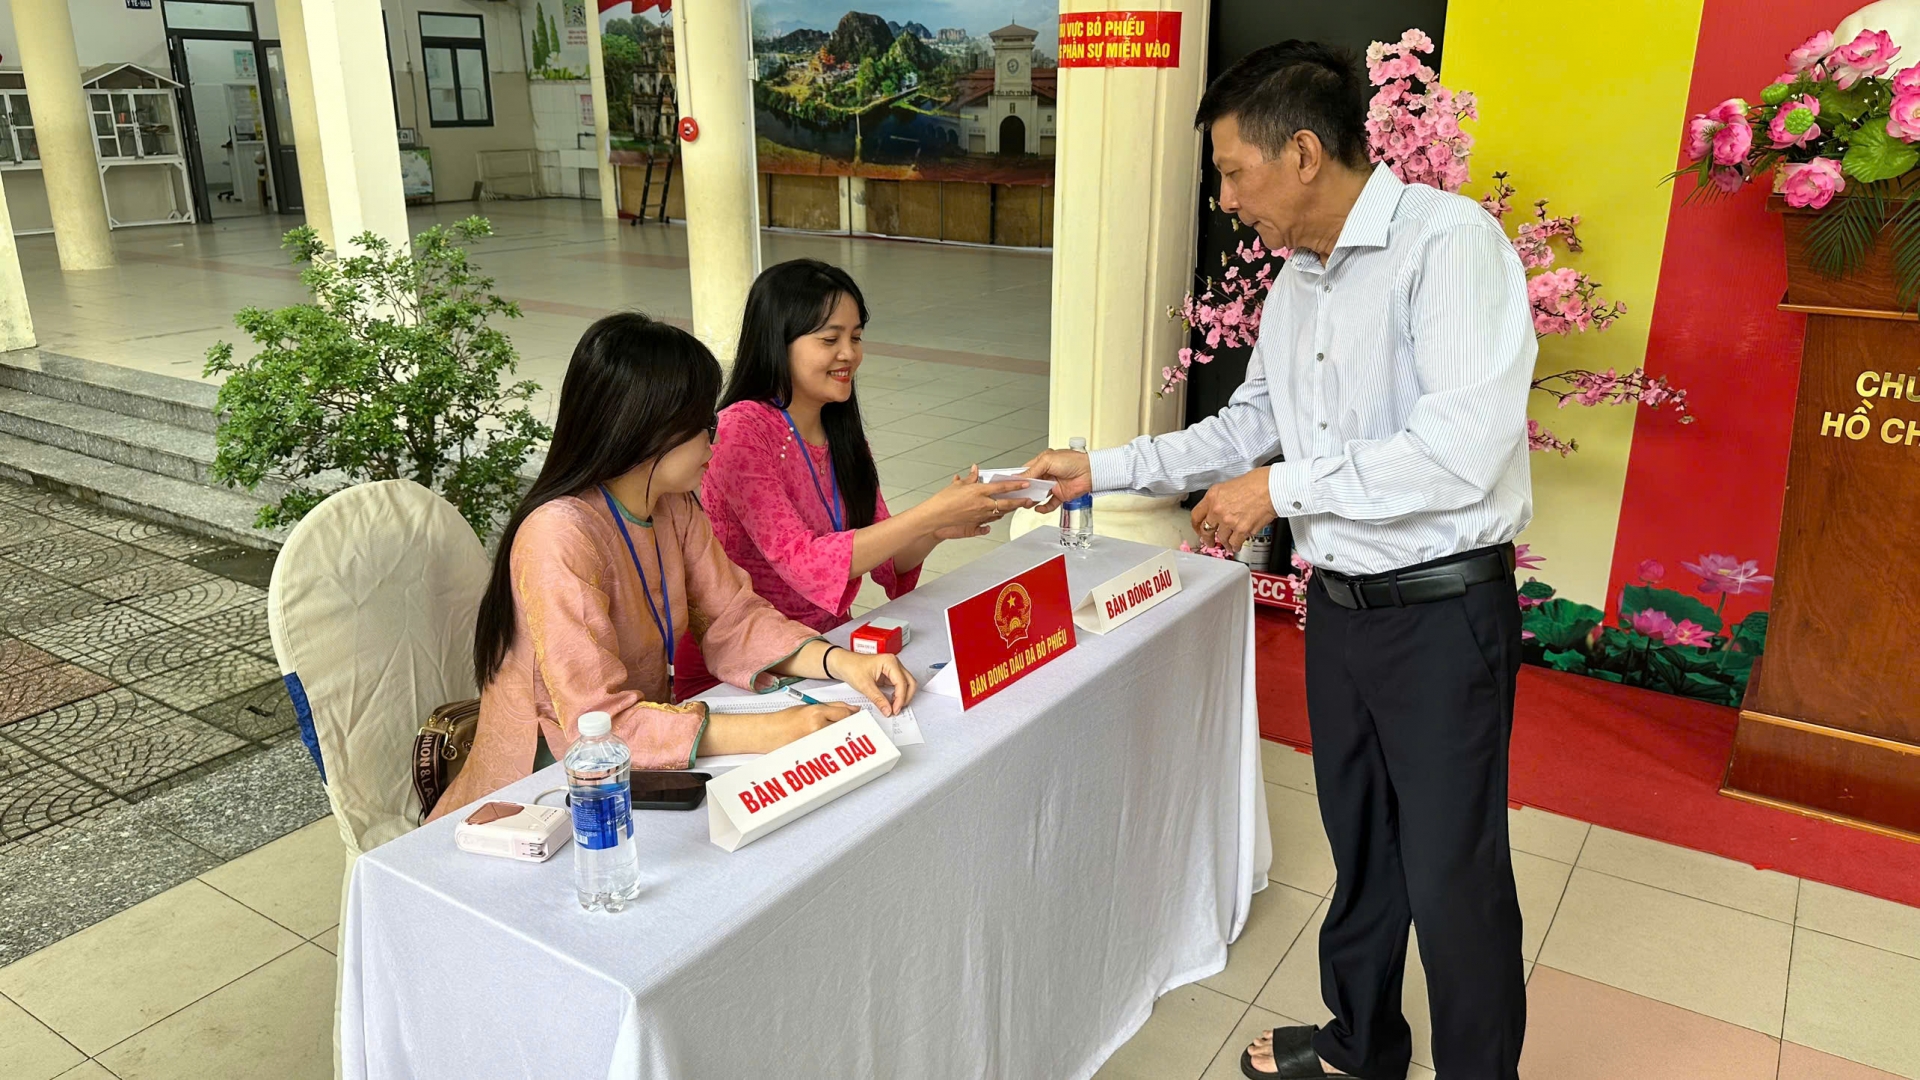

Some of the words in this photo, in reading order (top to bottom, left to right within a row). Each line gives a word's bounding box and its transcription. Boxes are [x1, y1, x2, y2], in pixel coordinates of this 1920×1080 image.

[1062, 40, 1085, 62] PHẬN
[1087, 41, 1105, 62] SỰ
[1106, 36, 1141, 58] MIỄN
[1145, 39, 1171, 59] VÀO
[1067, 20, 1084, 41] VỰC
[1086, 16, 1102, 37] BỎ
[1105, 15, 1145, 37] PHIẾU
[1820, 398, 1875, 441] HỒ
[1105, 593, 1128, 620] BÀN
[1127, 579, 1154, 608] ĐÓNG
[1153, 565, 1173, 594] DẤU
[969, 673, 988, 698] BÀN
[987, 662, 1010, 688] ĐÓNG
[1009, 648, 1026, 676] DẤU
[1024, 643, 1037, 666] ĐÃ
[1035, 634, 1047, 660] BỎ
[1046, 625, 1068, 654] PHIẾU
[738, 777, 789, 814] BÀN
[782, 753, 841, 793] ĐÓNG
[834, 732, 877, 767] DẤU
